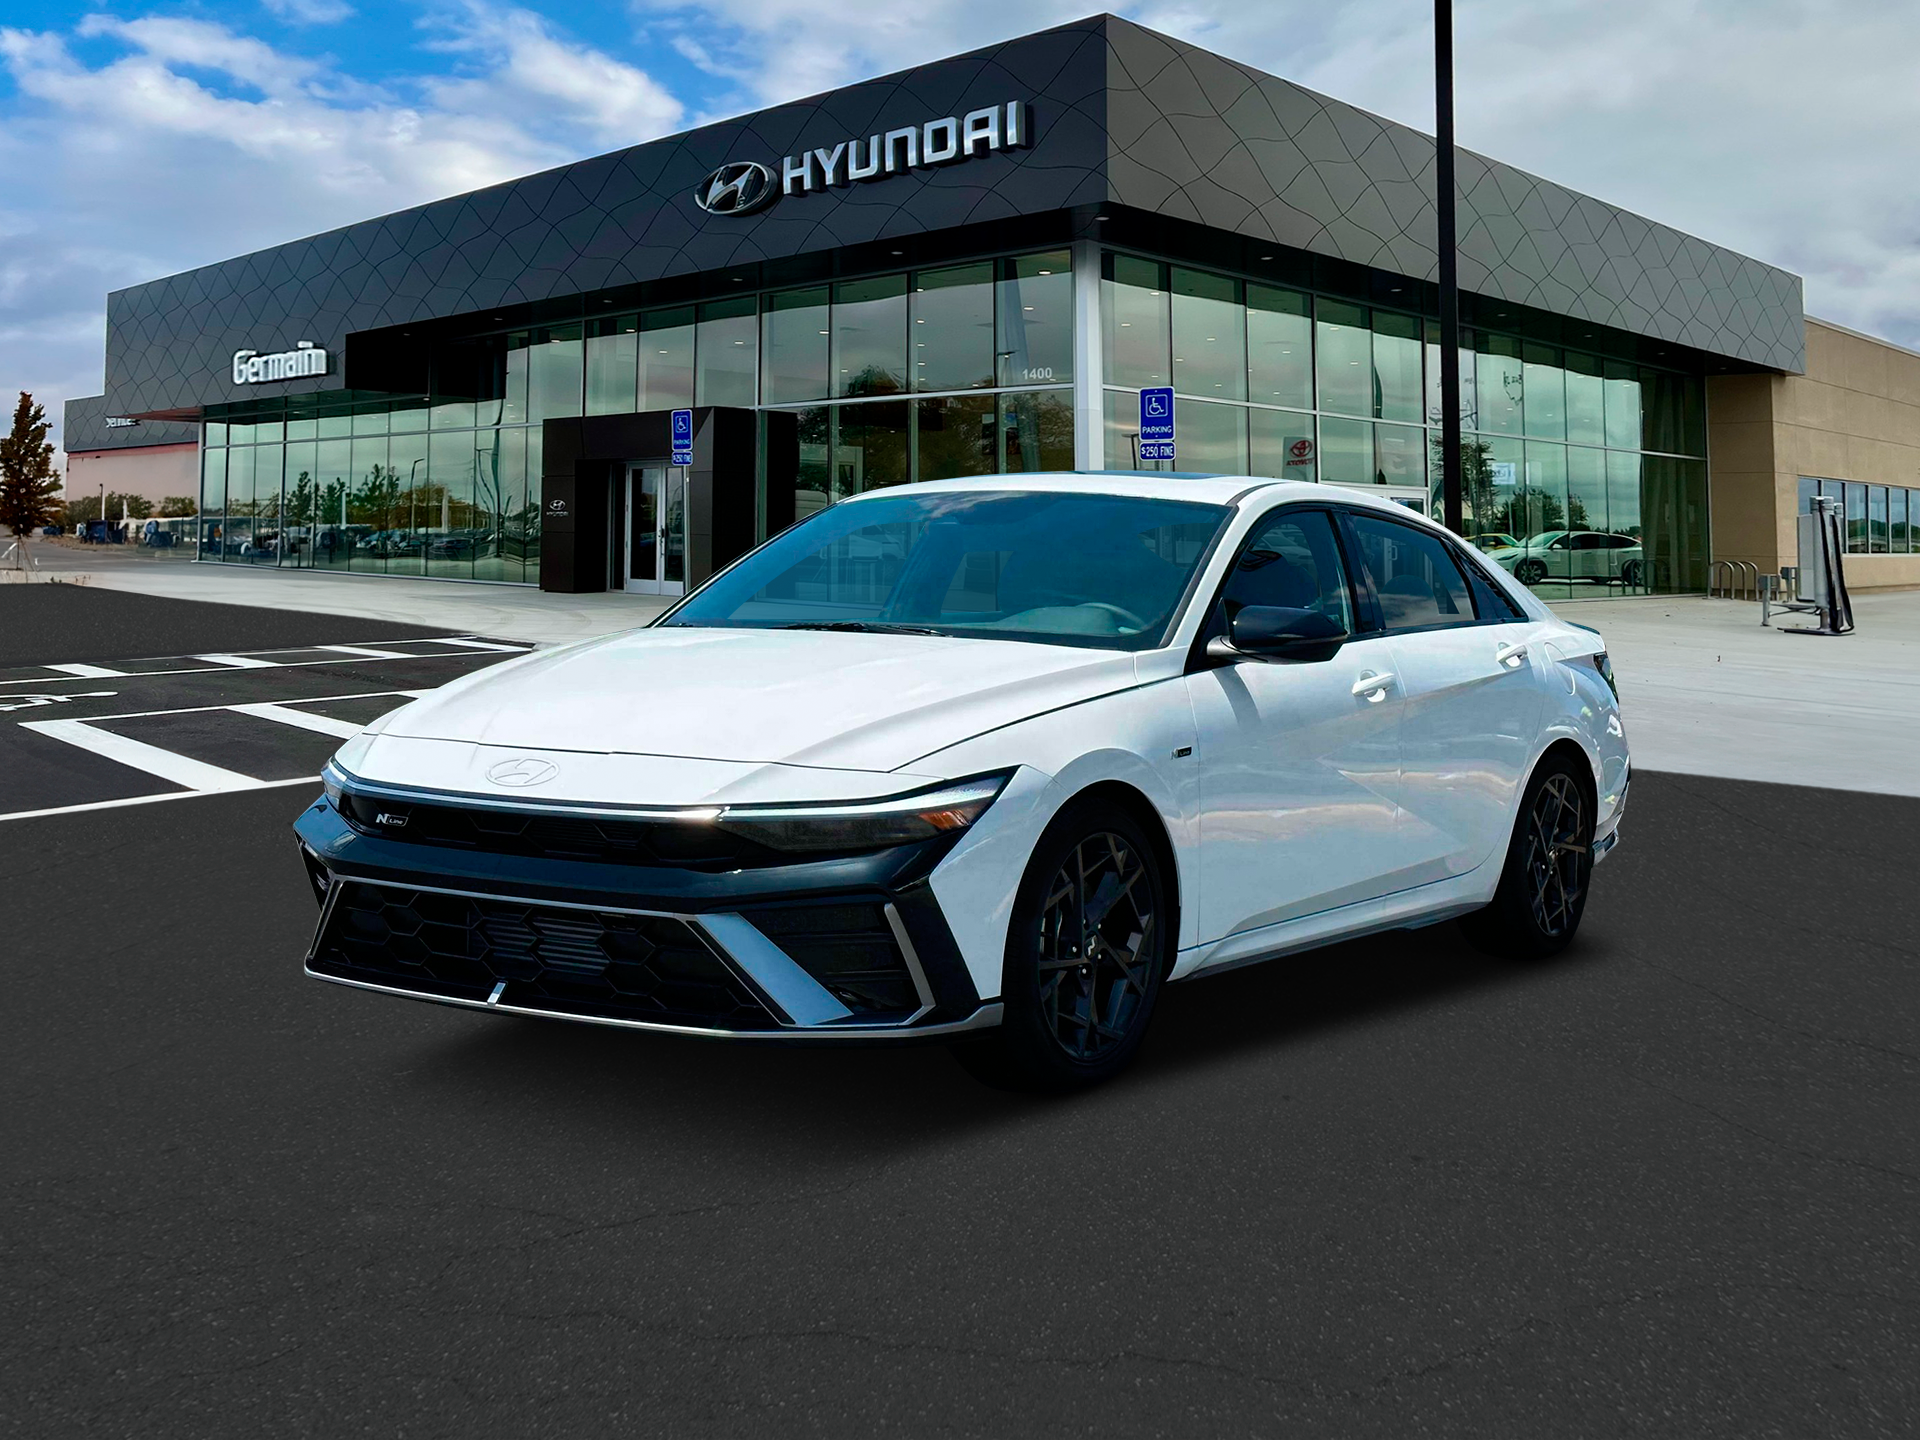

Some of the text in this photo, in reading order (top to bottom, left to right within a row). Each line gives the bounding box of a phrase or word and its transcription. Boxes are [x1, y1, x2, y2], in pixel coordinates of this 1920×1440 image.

[783, 100, 1026, 195] HYUNDAI
[232, 341, 328, 385] Germain
[1022, 367, 1053, 380] 1400
[1142, 426, 1172, 434] PARKING
[1141, 445, 1174, 457] $250 FINE
